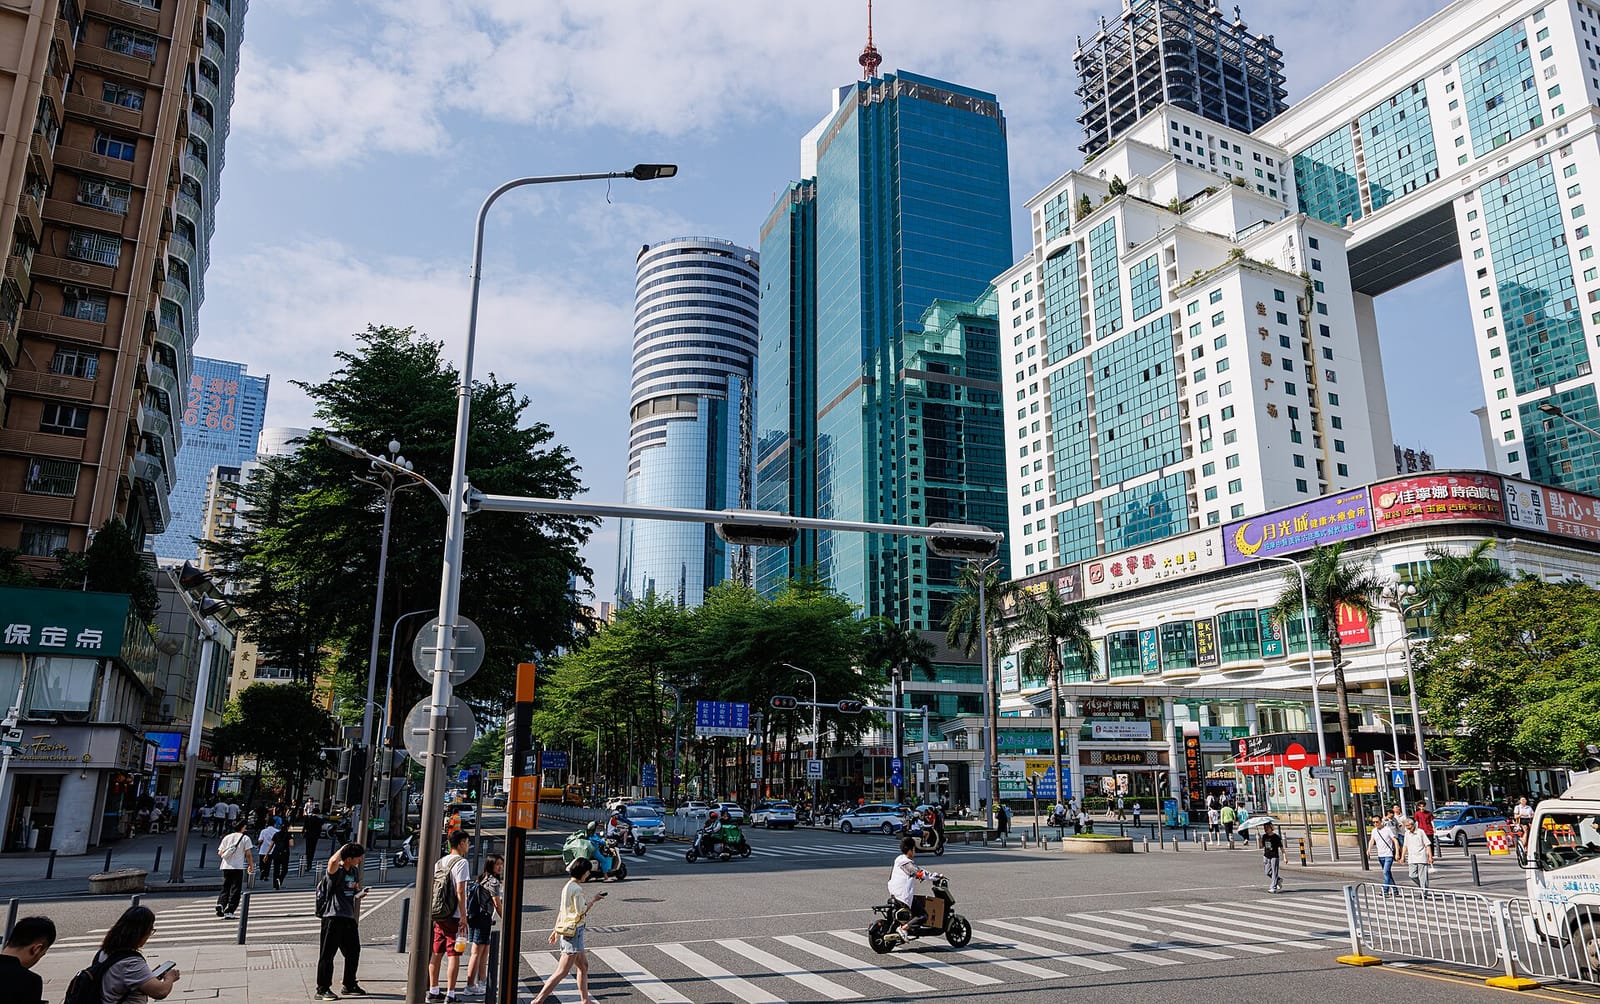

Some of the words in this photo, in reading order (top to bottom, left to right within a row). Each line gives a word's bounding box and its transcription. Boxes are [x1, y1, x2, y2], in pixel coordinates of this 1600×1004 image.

[1262, 511, 1309, 541] 月光城
[4, 623, 104, 649] 保定点
[1204, 622, 1213, 651] KTV
[1266, 643, 1277, 653] 4F
